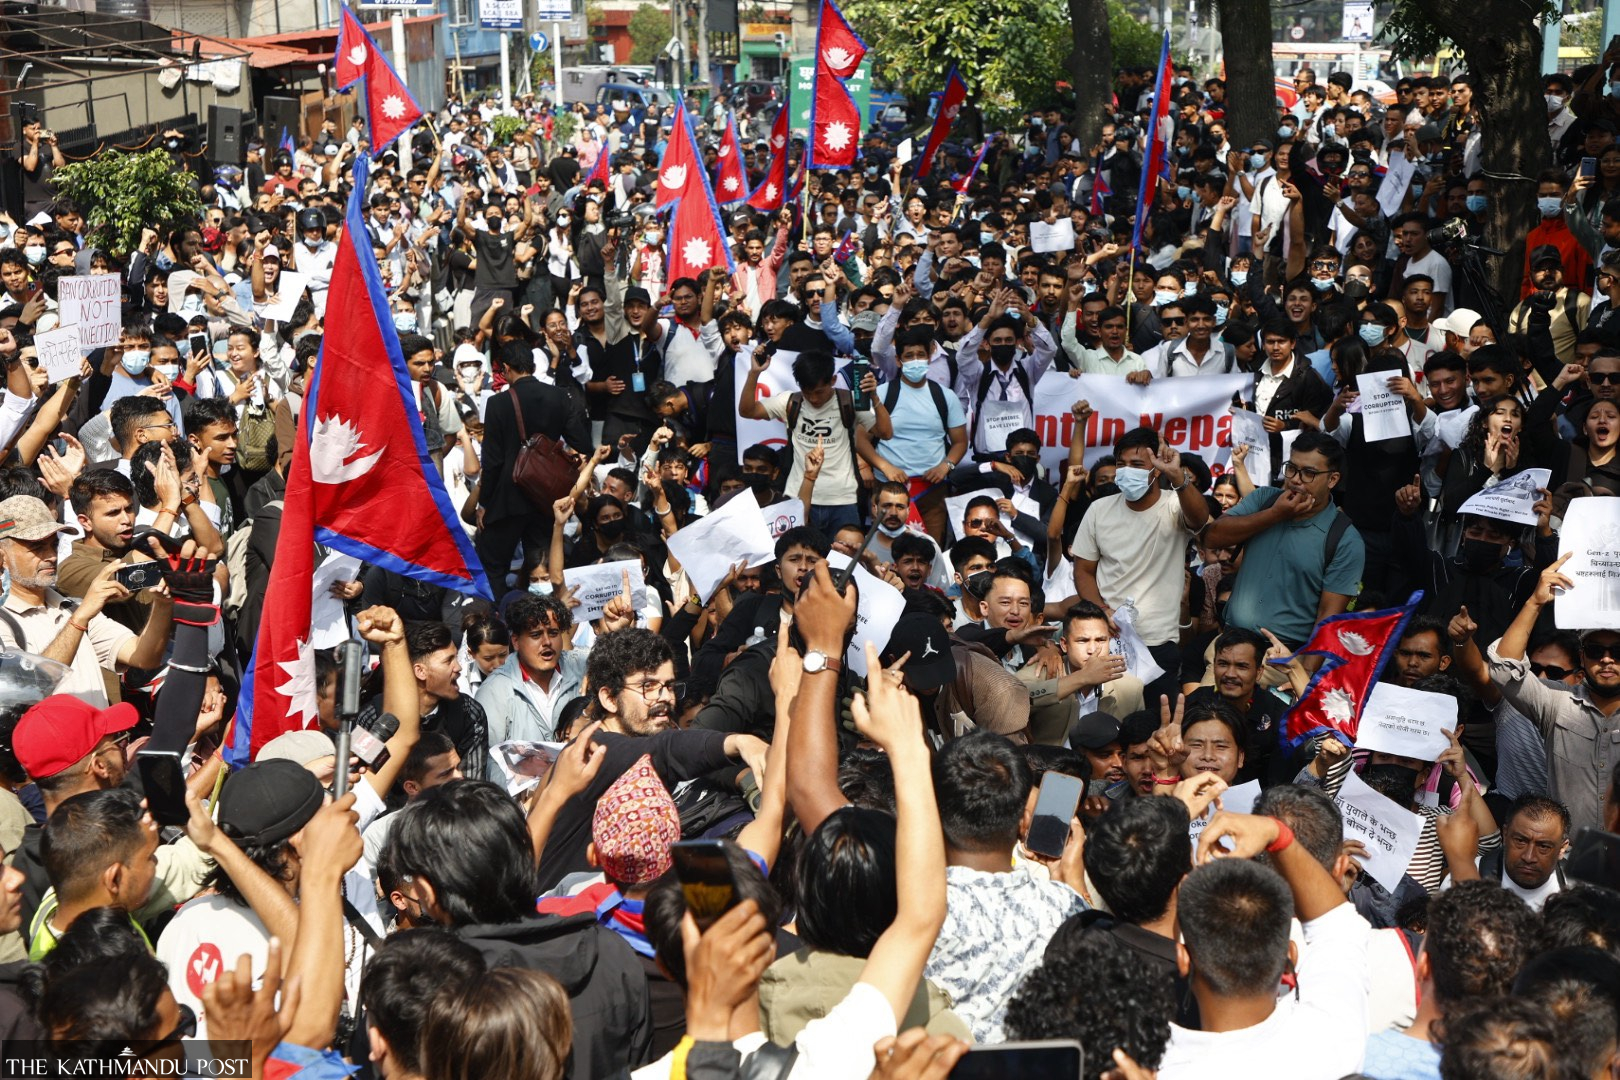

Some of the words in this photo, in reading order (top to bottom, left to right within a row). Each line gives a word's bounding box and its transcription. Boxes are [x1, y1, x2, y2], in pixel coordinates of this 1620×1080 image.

[60, 280, 78, 300] BAN
[80, 300, 114, 322] NOT
[1364, 400, 1402, 410] CORRUPTION
[798, 434, 836, 444] DREAMTAR
[585, 590, 623, 600] CORRUPTIO
[1346, 803, 1369, 821] युवाले
[1370, 815, 1378, 826] के
[1346, 817, 1367, 834] बोल्न
[1369, 827, 1375, 840] दे
